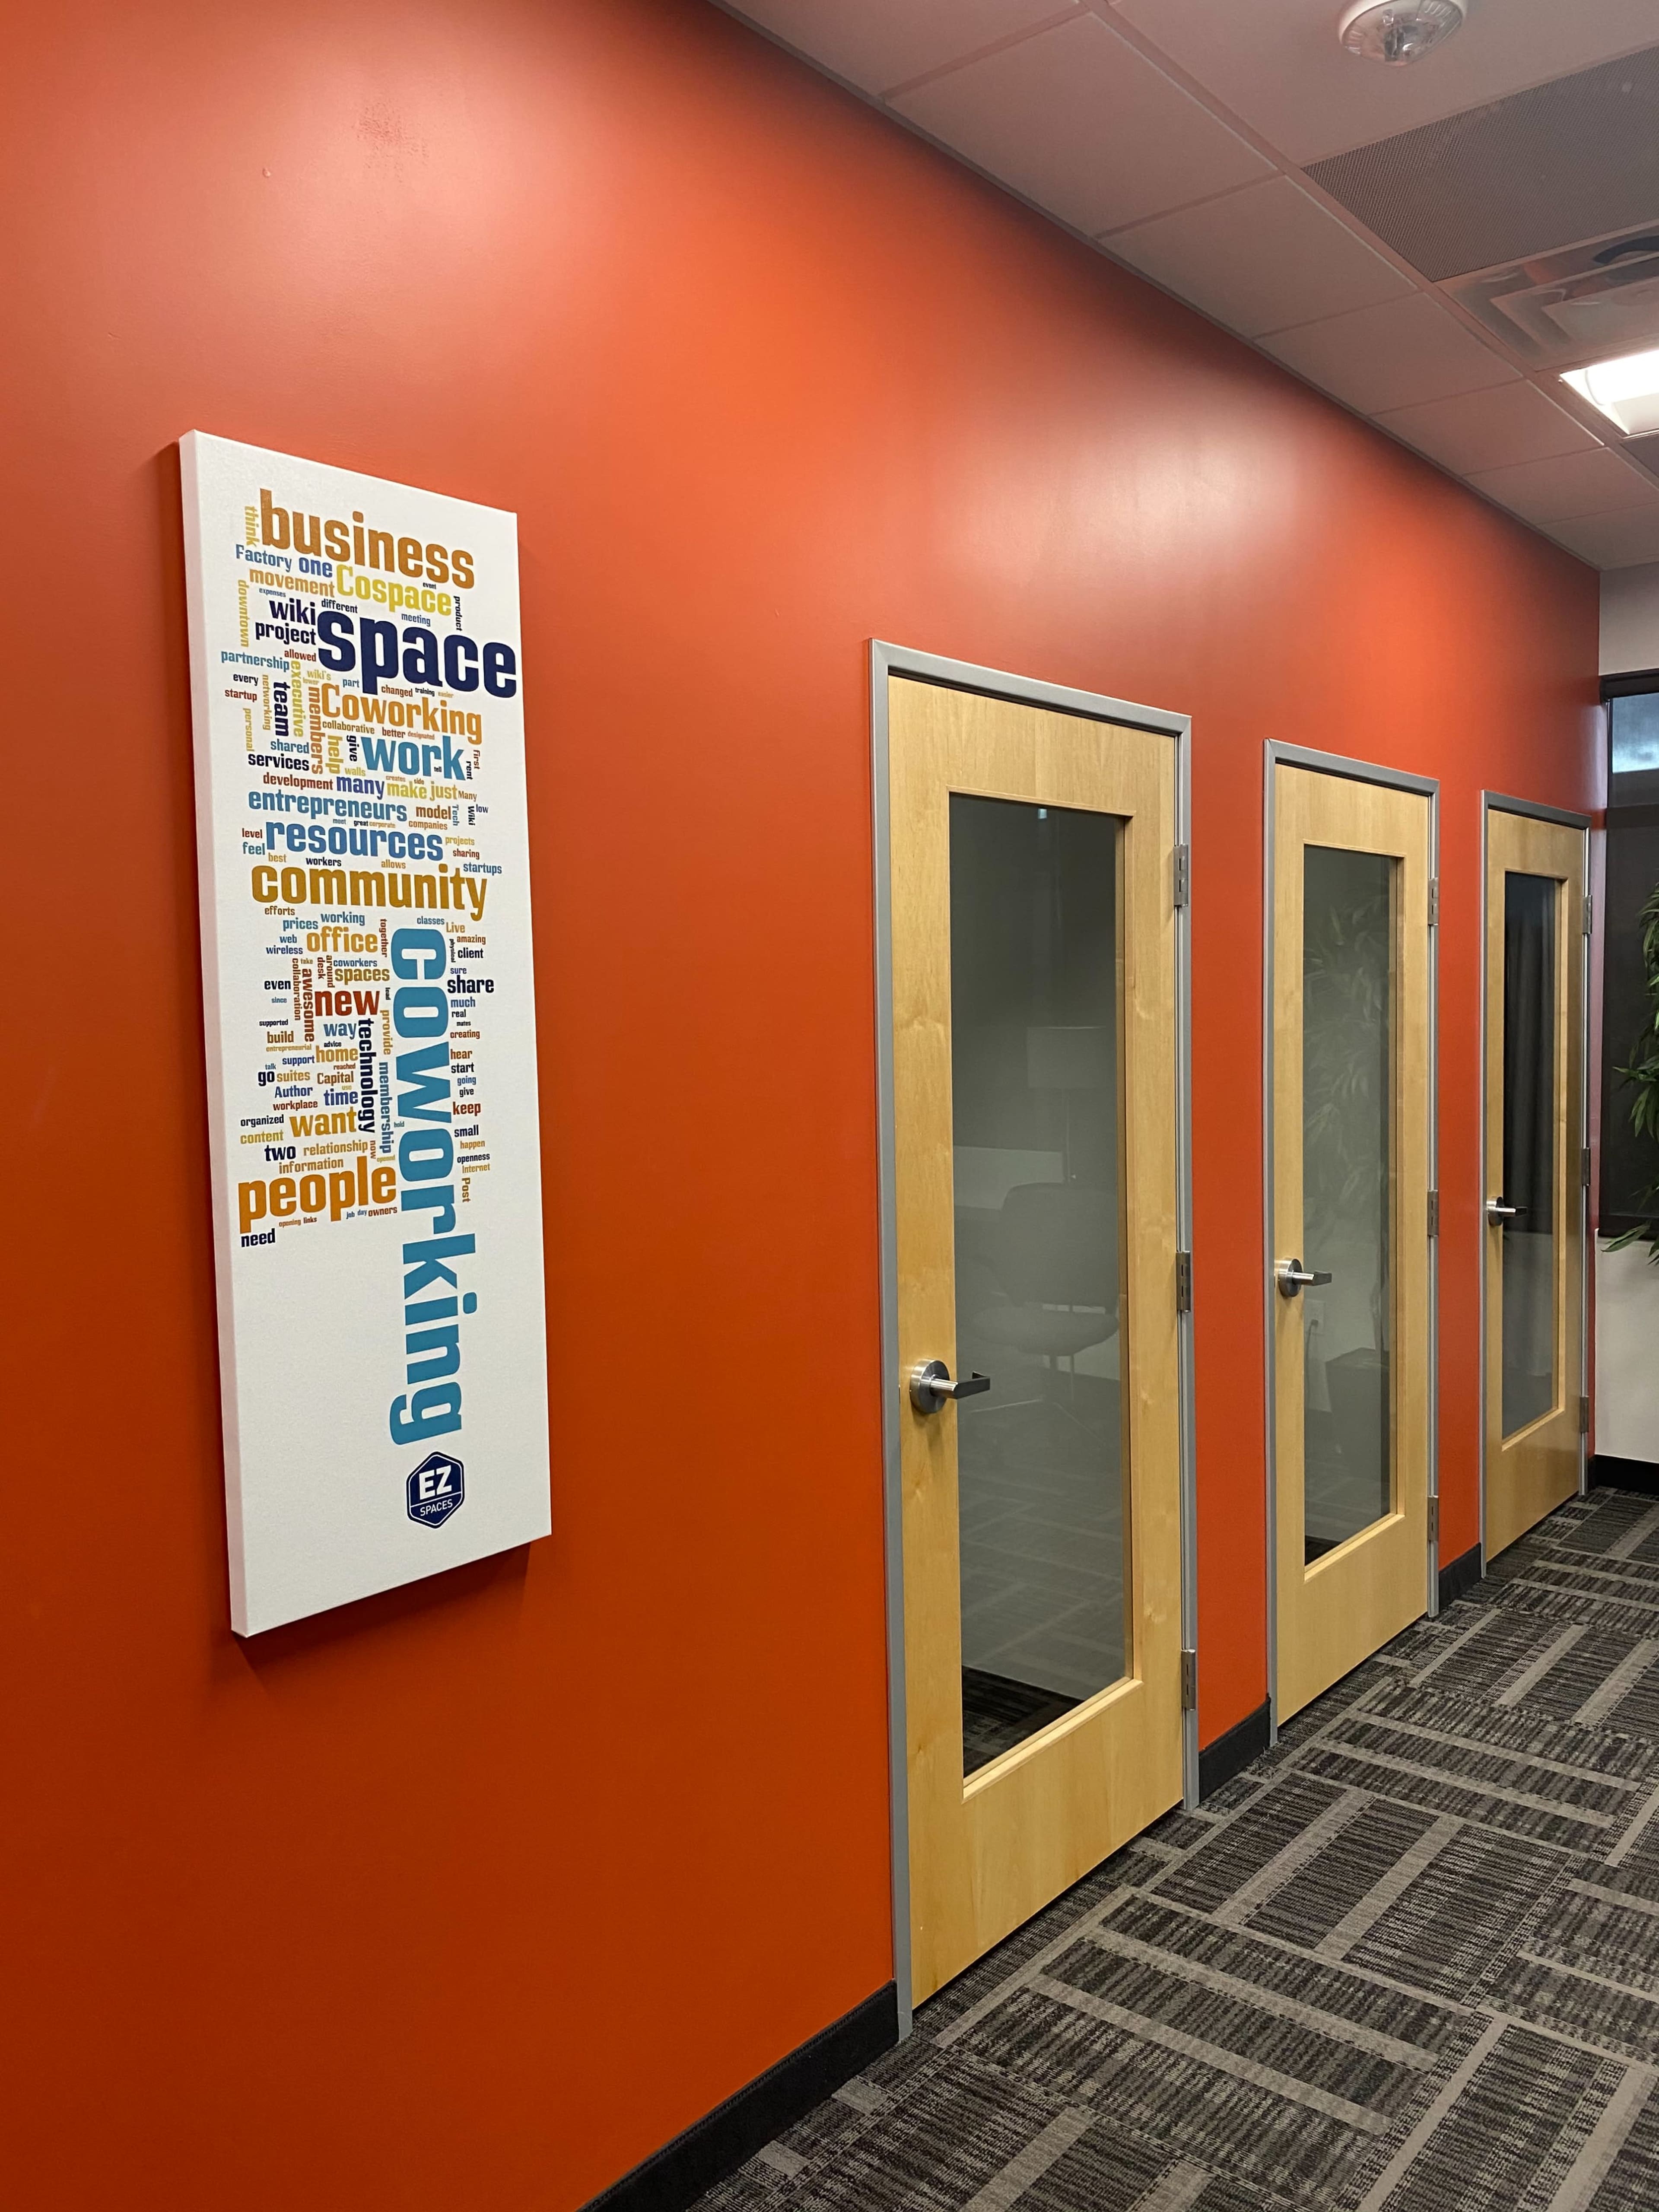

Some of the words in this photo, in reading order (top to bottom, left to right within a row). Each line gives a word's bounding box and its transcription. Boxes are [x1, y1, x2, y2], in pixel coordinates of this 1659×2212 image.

[245, 505, 260, 547] think
[260, 488, 475, 589] business
[235, 544, 292, 572] Factory
[299, 557, 333, 578] one
[249, 569, 335, 597] movement
[337, 564, 451, 616] Cospace
[259, 588, 286, 597] expenses
[269, 597, 316, 626] wiki
[321, 598, 358, 613] different
[454, 595, 463, 631] product
[238, 580, 249, 647] downtown
[401, 613, 431, 627] meeting
[255, 622, 316, 645] project
[221, 651, 290, 672] partnership
[284, 648, 316, 662] allowed
[318, 610, 517, 699] space
[233, 674, 258, 686] every
[307, 669, 331, 681] wiki's
[343, 678, 359, 688] part
[225, 689, 257, 702] startup
[291, 660, 306, 737] executive
[381, 684, 413, 698] changed
[415, 687, 435, 696] training
[263, 675, 272, 731] networking
[273, 682, 290, 737] team
[321, 683, 482, 745] Coworking
[243, 708, 255, 752] personal
[308, 686, 325, 774] members
[322, 721, 375, 734] collaborative
[382, 727, 406, 738] better
[408, 731, 435, 740] designated
[270, 738, 309, 754] shared
[346, 735, 359, 762] give
[248, 753, 309, 771] services
[325, 735, 344, 774] help
[361, 735, 466, 781] work
[345, 766, 366, 777] walls
[263, 772, 333, 790] development
[337, 776, 385, 800] many
[387, 781, 427, 799] make
[430, 781, 458, 801] just
[458, 790, 477, 802] Many
[248, 789, 407, 822] entrepreneurs
[416, 805, 451, 820] model
[476, 804, 489, 813] low
[369, 821, 396, 829] corporate
[408, 820, 448, 830] companies
[242, 828, 263, 839] level
[445, 836, 475, 846] projects
[242, 842, 265, 855] feel
[266, 822, 443, 861] resources
[268, 852, 286, 862] best
[306, 857, 342, 867] workers
[453, 849, 480, 860] sharing
[381, 859, 406, 869] allows
[463, 862, 502, 876] startups
[251, 864, 487, 922] community
[264, 906, 295, 916] efforts
[283, 917, 318, 931] prices
[321, 912, 365, 926] working
[417, 916, 445, 925] classes
[446, 922, 465, 933] Live
[280, 934, 297, 944] web
[306, 926, 378, 953] office
[379, 918, 389, 958] together
[457, 934, 486, 945] amazing
[266, 945, 303, 954] wireless
[458, 947, 483, 959] client
[318, 957, 326, 979] desk
[333, 958, 377, 967] coworkers
[326, 955, 335, 988] around
[335, 968, 390, 985] spaces
[264, 980, 291, 990] even
[292, 958, 302, 1021] collaboration
[447, 975, 494, 994] share
[302, 968, 315, 1042] awesome
[315, 990, 380, 1017] new
[451, 996, 476, 1008] much
[451, 1009, 466, 1018] real
[259, 1019, 289, 1027] supported
[323, 1022, 356, 1039] way
[267, 1031, 294, 1044] build
[380, 1010, 393, 1055] provide
[450, 1030, 480, 1039] creating
[266, 1044, 312, 1052] entrepreneurial
[316, 1046, 358, 1063] home
[450, 1049, 473, 1060] hear
[282, 1055, 315, 1066] support
[451, 1062, 474, 1074] start
[257, 1071, 275, 1087] go
[276, 1070, 310, 1082] suites
[317, 1071, 354, 1086] Capital
[358, 1018, 379, 1133] technology
[457, 1075, 476, 1086] going
[274, 1085, 313, 1098] Author
[324, 1088, 358, 1106] time
[459, 1087, 474, 1097] give
[273, 1100, 318, 1111] workplace
[379, 1062, 394, 1154] membership
[453, 1101, 481, 1116] keep
[240, 1114, 284, 1128] organized
[289, 1106, 357, 1138] want
[240, 1130, 284, 1144] content
[454, 1125, 479, 1137] small
[303, 1139, 368, 1156] relationship
[460, 1140, 485, 1150] happen
[264, 1145, 296, 1162] two
[457, 1153, 490, 1164] openness
[279, 1157, 343, 1174] information
[462, 1163, 490, 1173] Internet
[390, 928, 477, 1445] coworking
[462, 1177, 470, 1202] Post
[238, 1156, 396, 1234] people
[369, 1207, 397, 1217] owners
[279, 1219, 301, 1228] opening
[241, 1228, 275, 1248] need
[419, 1465, 452, 1500] EZ
[420, 1499, 453, 1517] SPACES
